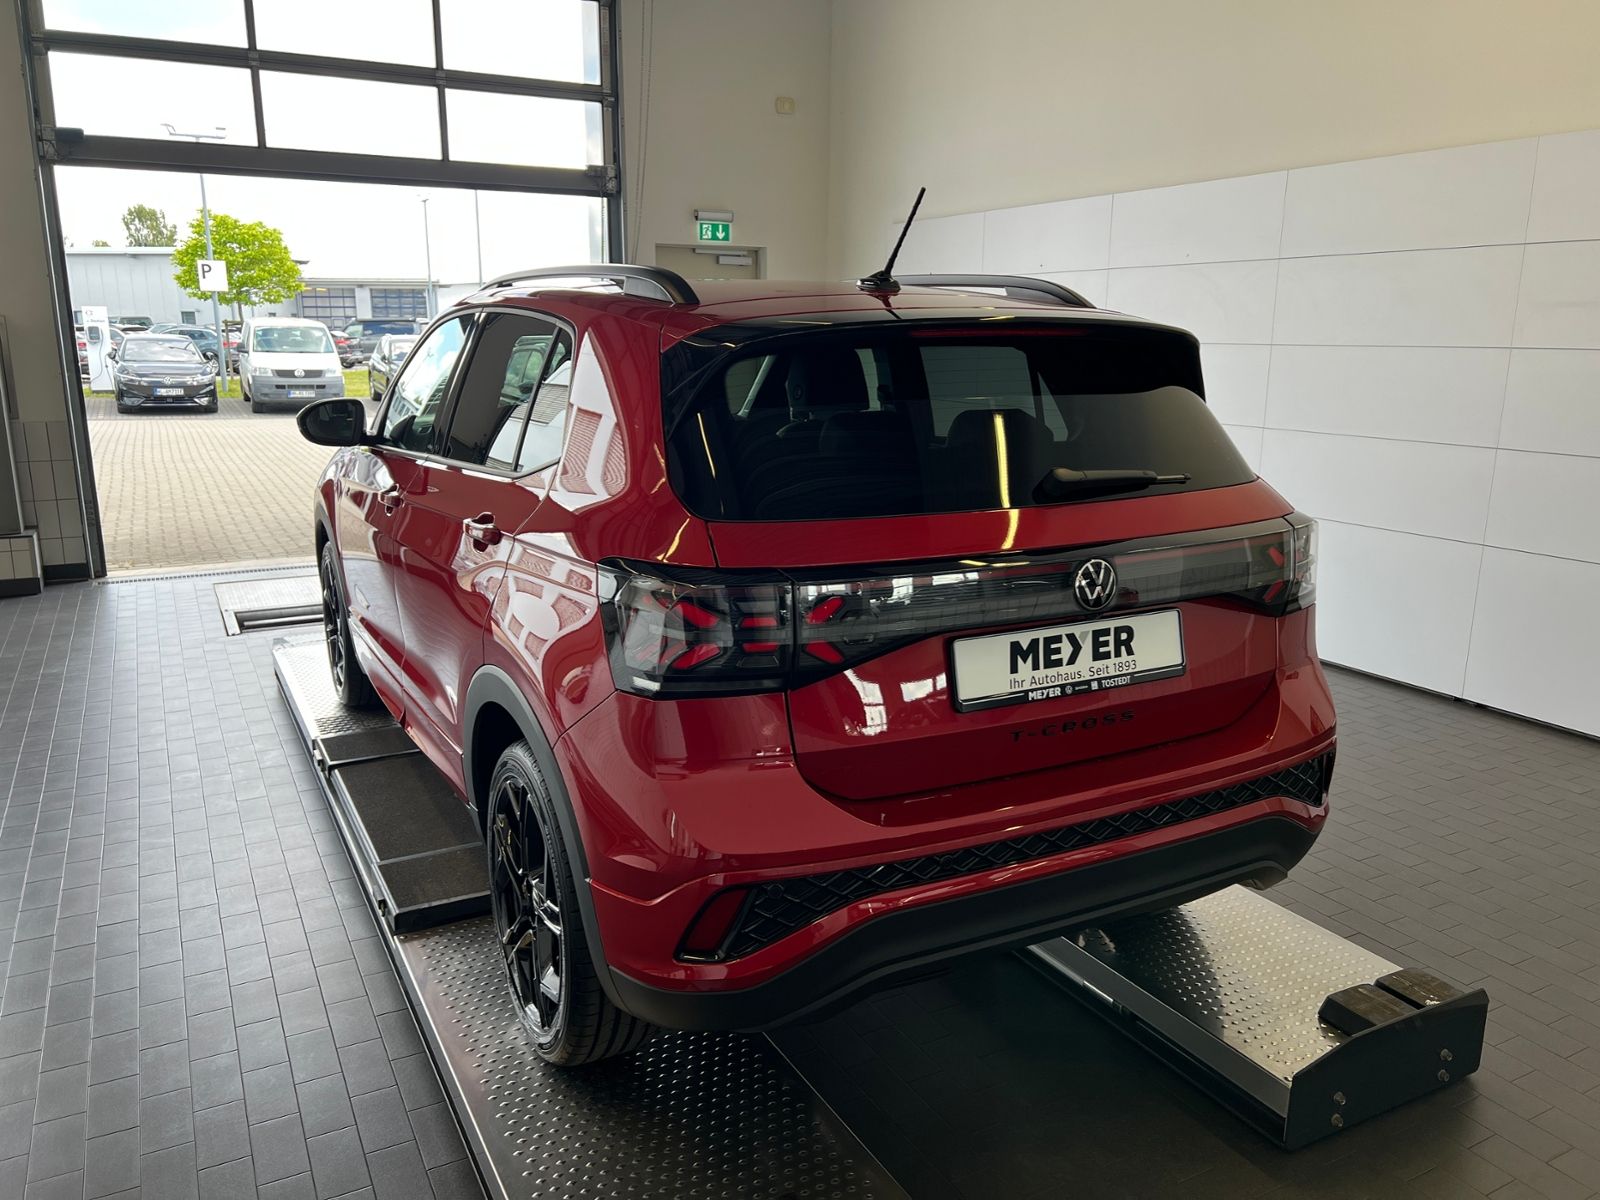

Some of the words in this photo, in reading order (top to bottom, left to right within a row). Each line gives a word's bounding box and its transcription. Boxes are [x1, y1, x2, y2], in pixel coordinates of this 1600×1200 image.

[201, 263, 212, 279] P
[1010, 625, 1135, 674] MEYER
[1009, 678, 1026, 690] Ihr
[1029, 670, 1086, 687] Autohaus.
[1088, 665, 1110, 678] Seit
[1113, 659, 1137, 673] 1893
[1028, 687, 1062, 701] MEYER
[1101, 675, 1131, 688] TOSTEDT
[1011, 709, 1136, 742] T-CROSS
